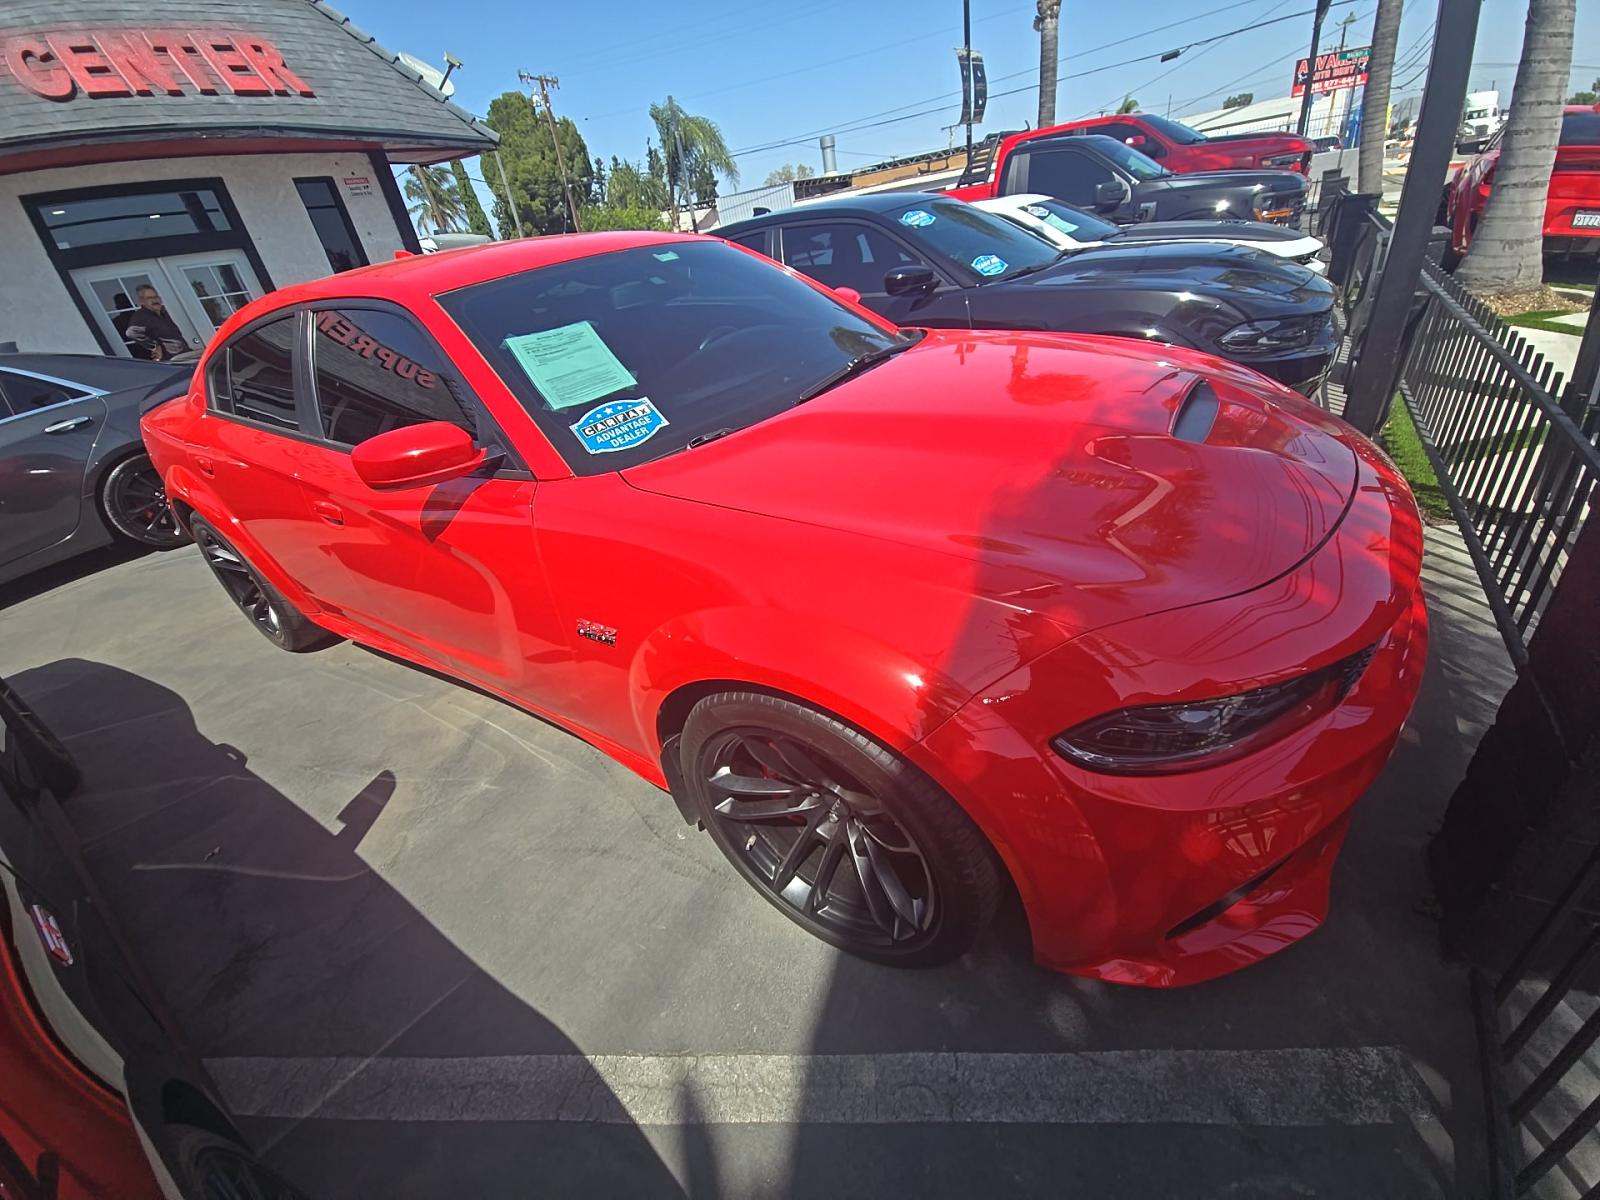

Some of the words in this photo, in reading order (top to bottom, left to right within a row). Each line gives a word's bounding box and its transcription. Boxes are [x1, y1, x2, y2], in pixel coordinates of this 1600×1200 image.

[4, 31, 315, 101] CENTER
[583, 405, 650, 437] CARFAX
[596, 416, 652, 443] ADVANTAGE
[610, 427, 649, 447] DEALER
